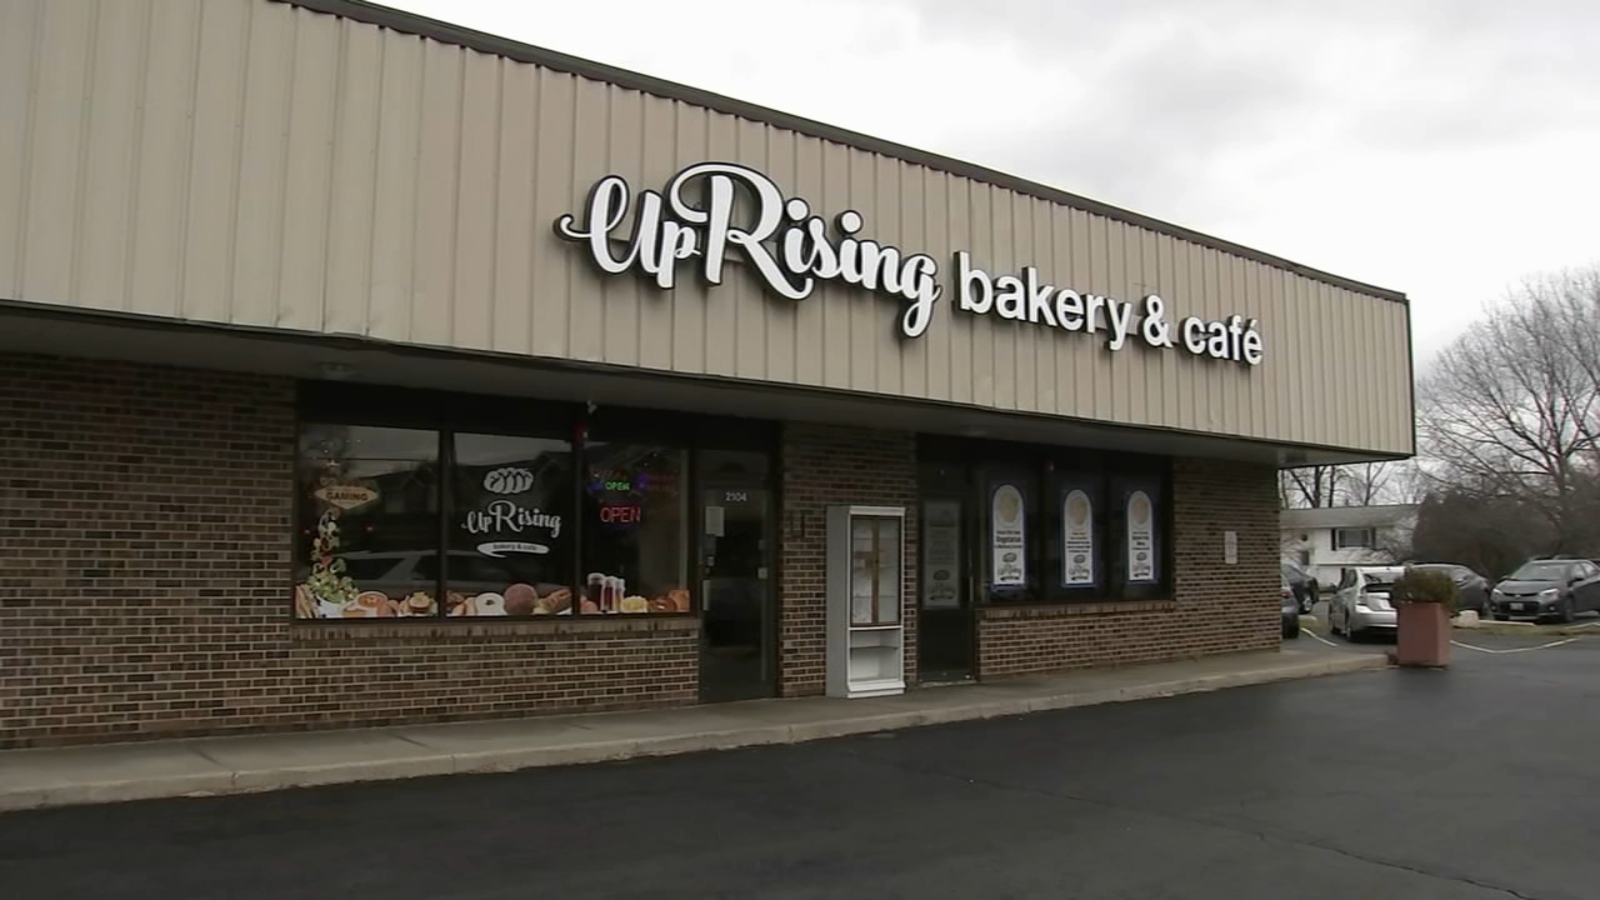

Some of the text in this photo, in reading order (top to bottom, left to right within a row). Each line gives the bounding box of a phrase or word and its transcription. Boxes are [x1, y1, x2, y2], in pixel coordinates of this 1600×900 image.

[555, 162, 1263, 365] UpRising bakery & café
[604, 481, 630, 491] OPEN
[326, 491, 369, 501] GAMING
[461, 500, 561, 538] UpRising
[600, 506, 641, 523] OPEN
